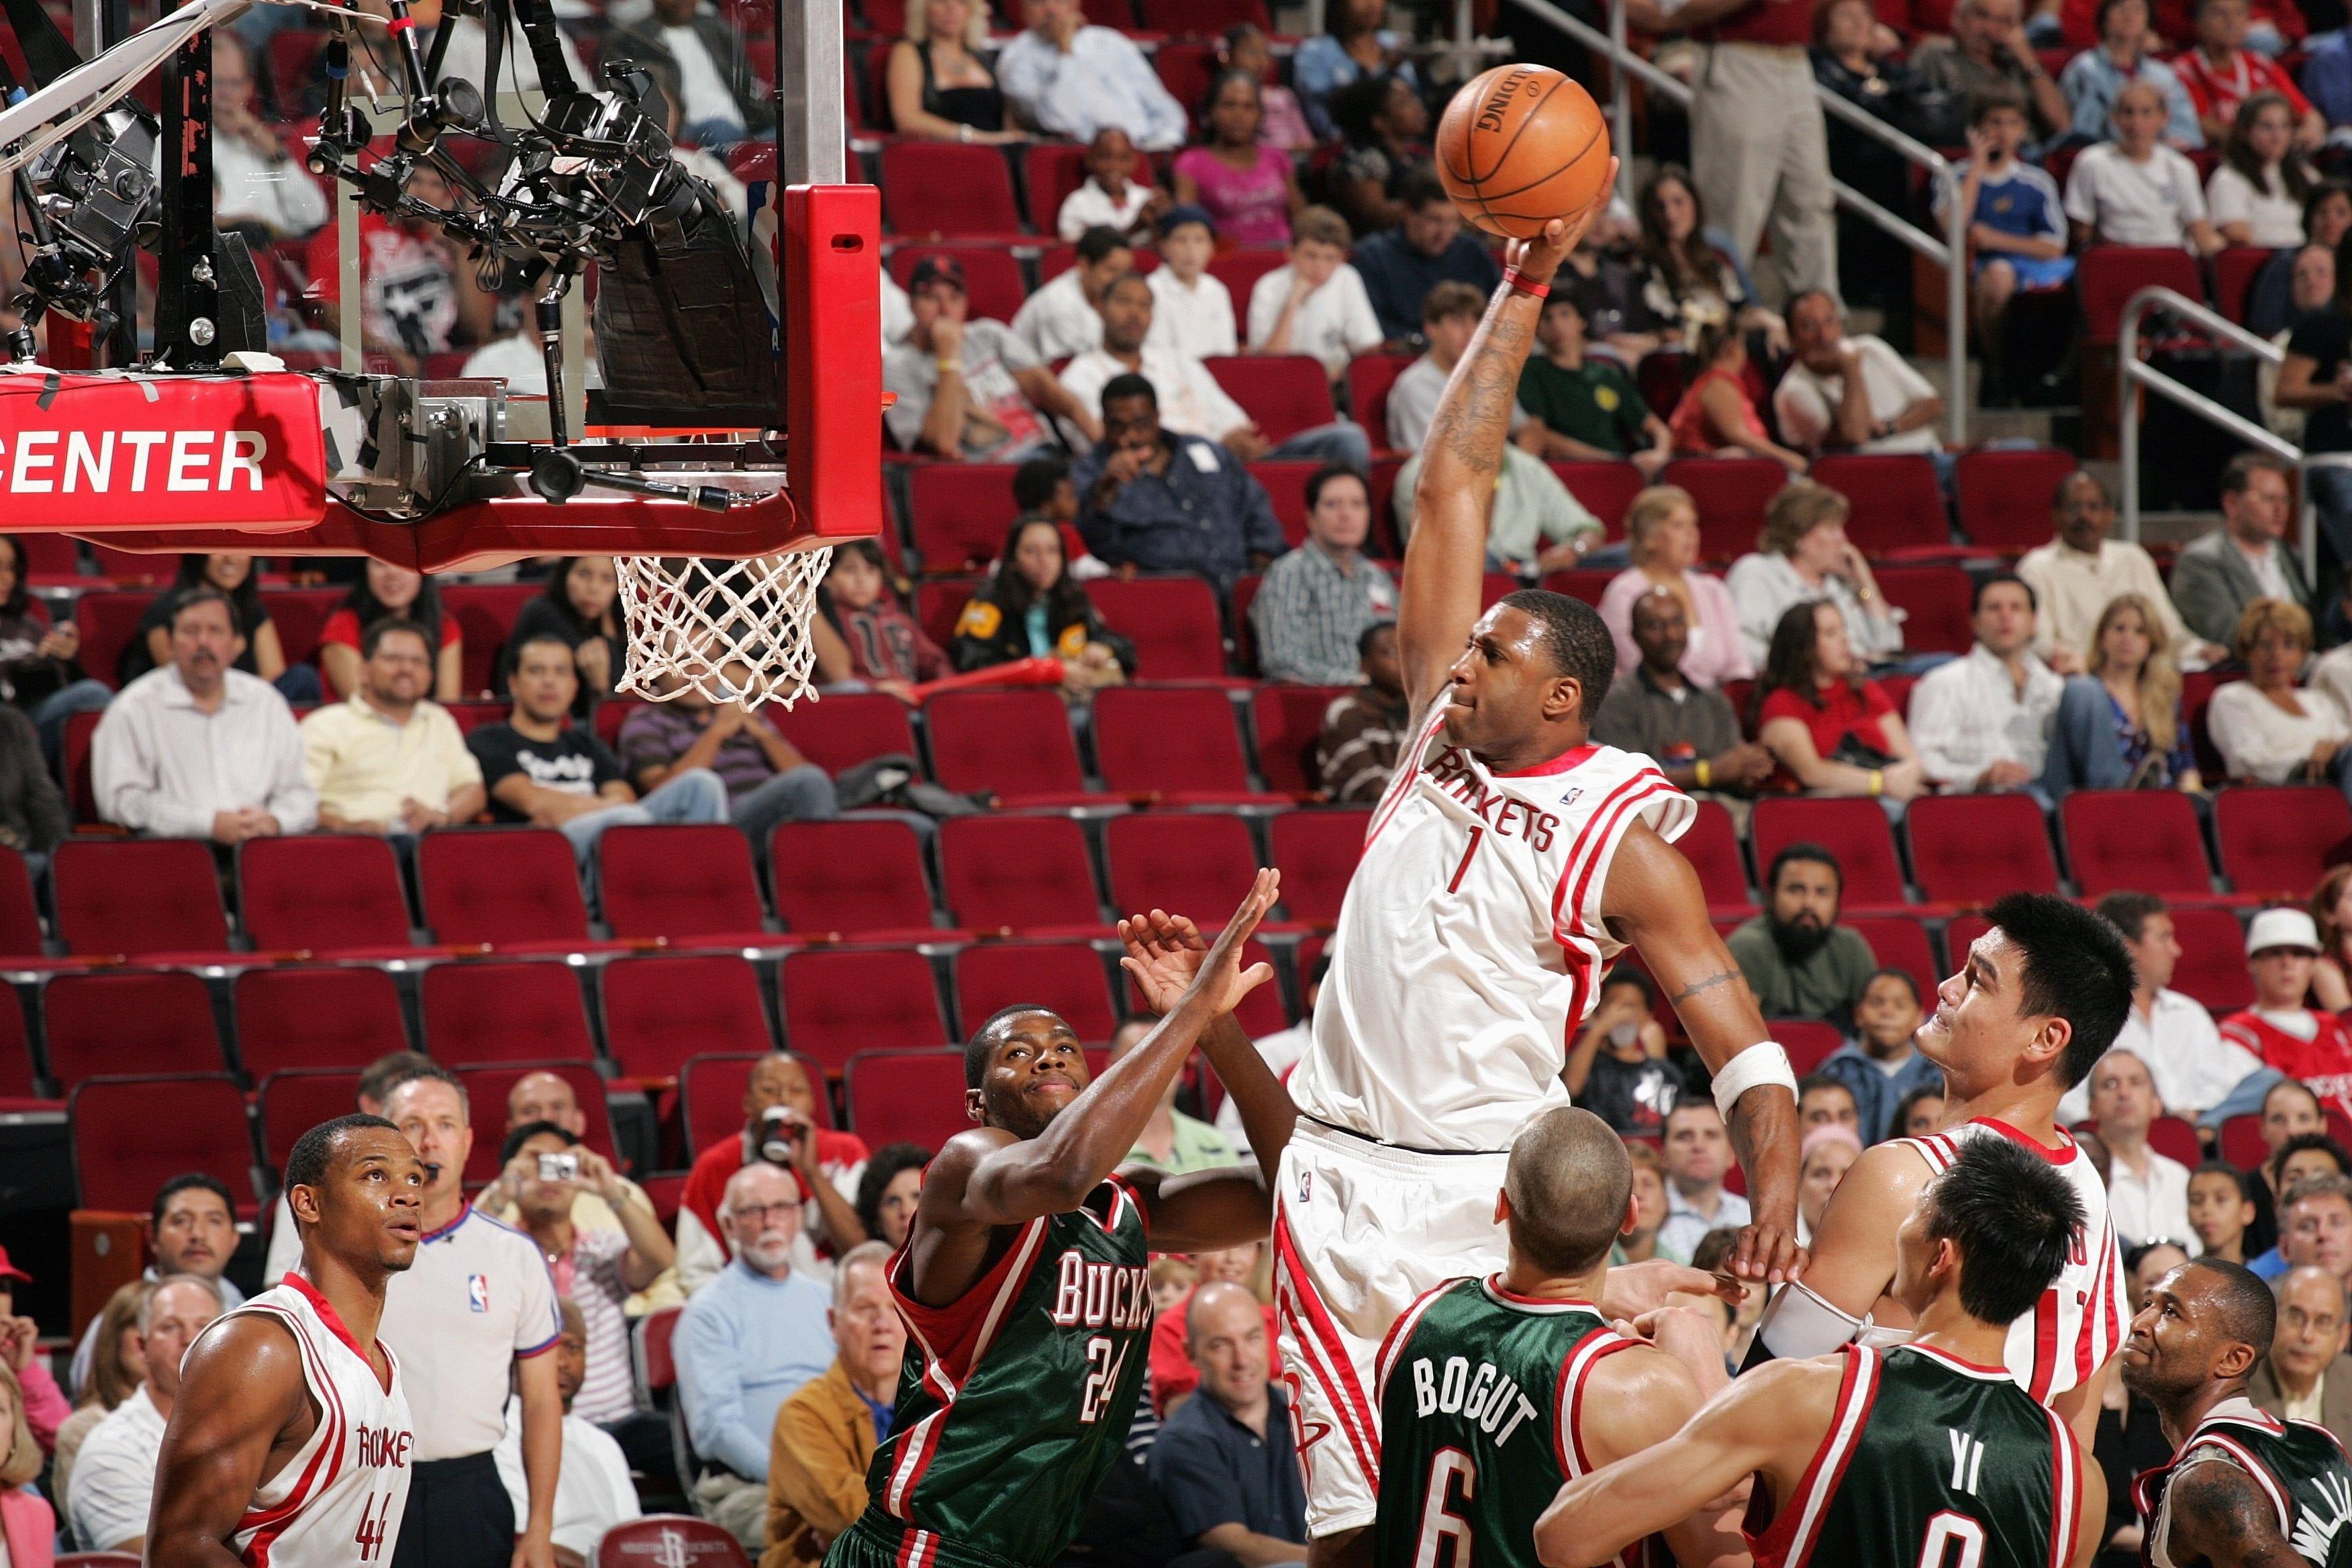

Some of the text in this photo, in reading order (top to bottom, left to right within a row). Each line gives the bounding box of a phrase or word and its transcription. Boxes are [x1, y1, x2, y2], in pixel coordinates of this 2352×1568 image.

[1476, 70, 1533, 133] ALDING
[0, 430, 267, 493] ENTER
[1447, 825, 1483, 895] 1
[1049, 1248, 1154, 1331] BUCKS
[1079, 1336, 1130, 1424] 24
[1412, 1356, 1538, 1448] BOGUT
[356, 1420, 414, 1469] ROCKE
[1949, 1428, 1984, 1496] YI
[355, 1491, 392, 1561] 44
[1412, 1445, 1477, 1568] 6
